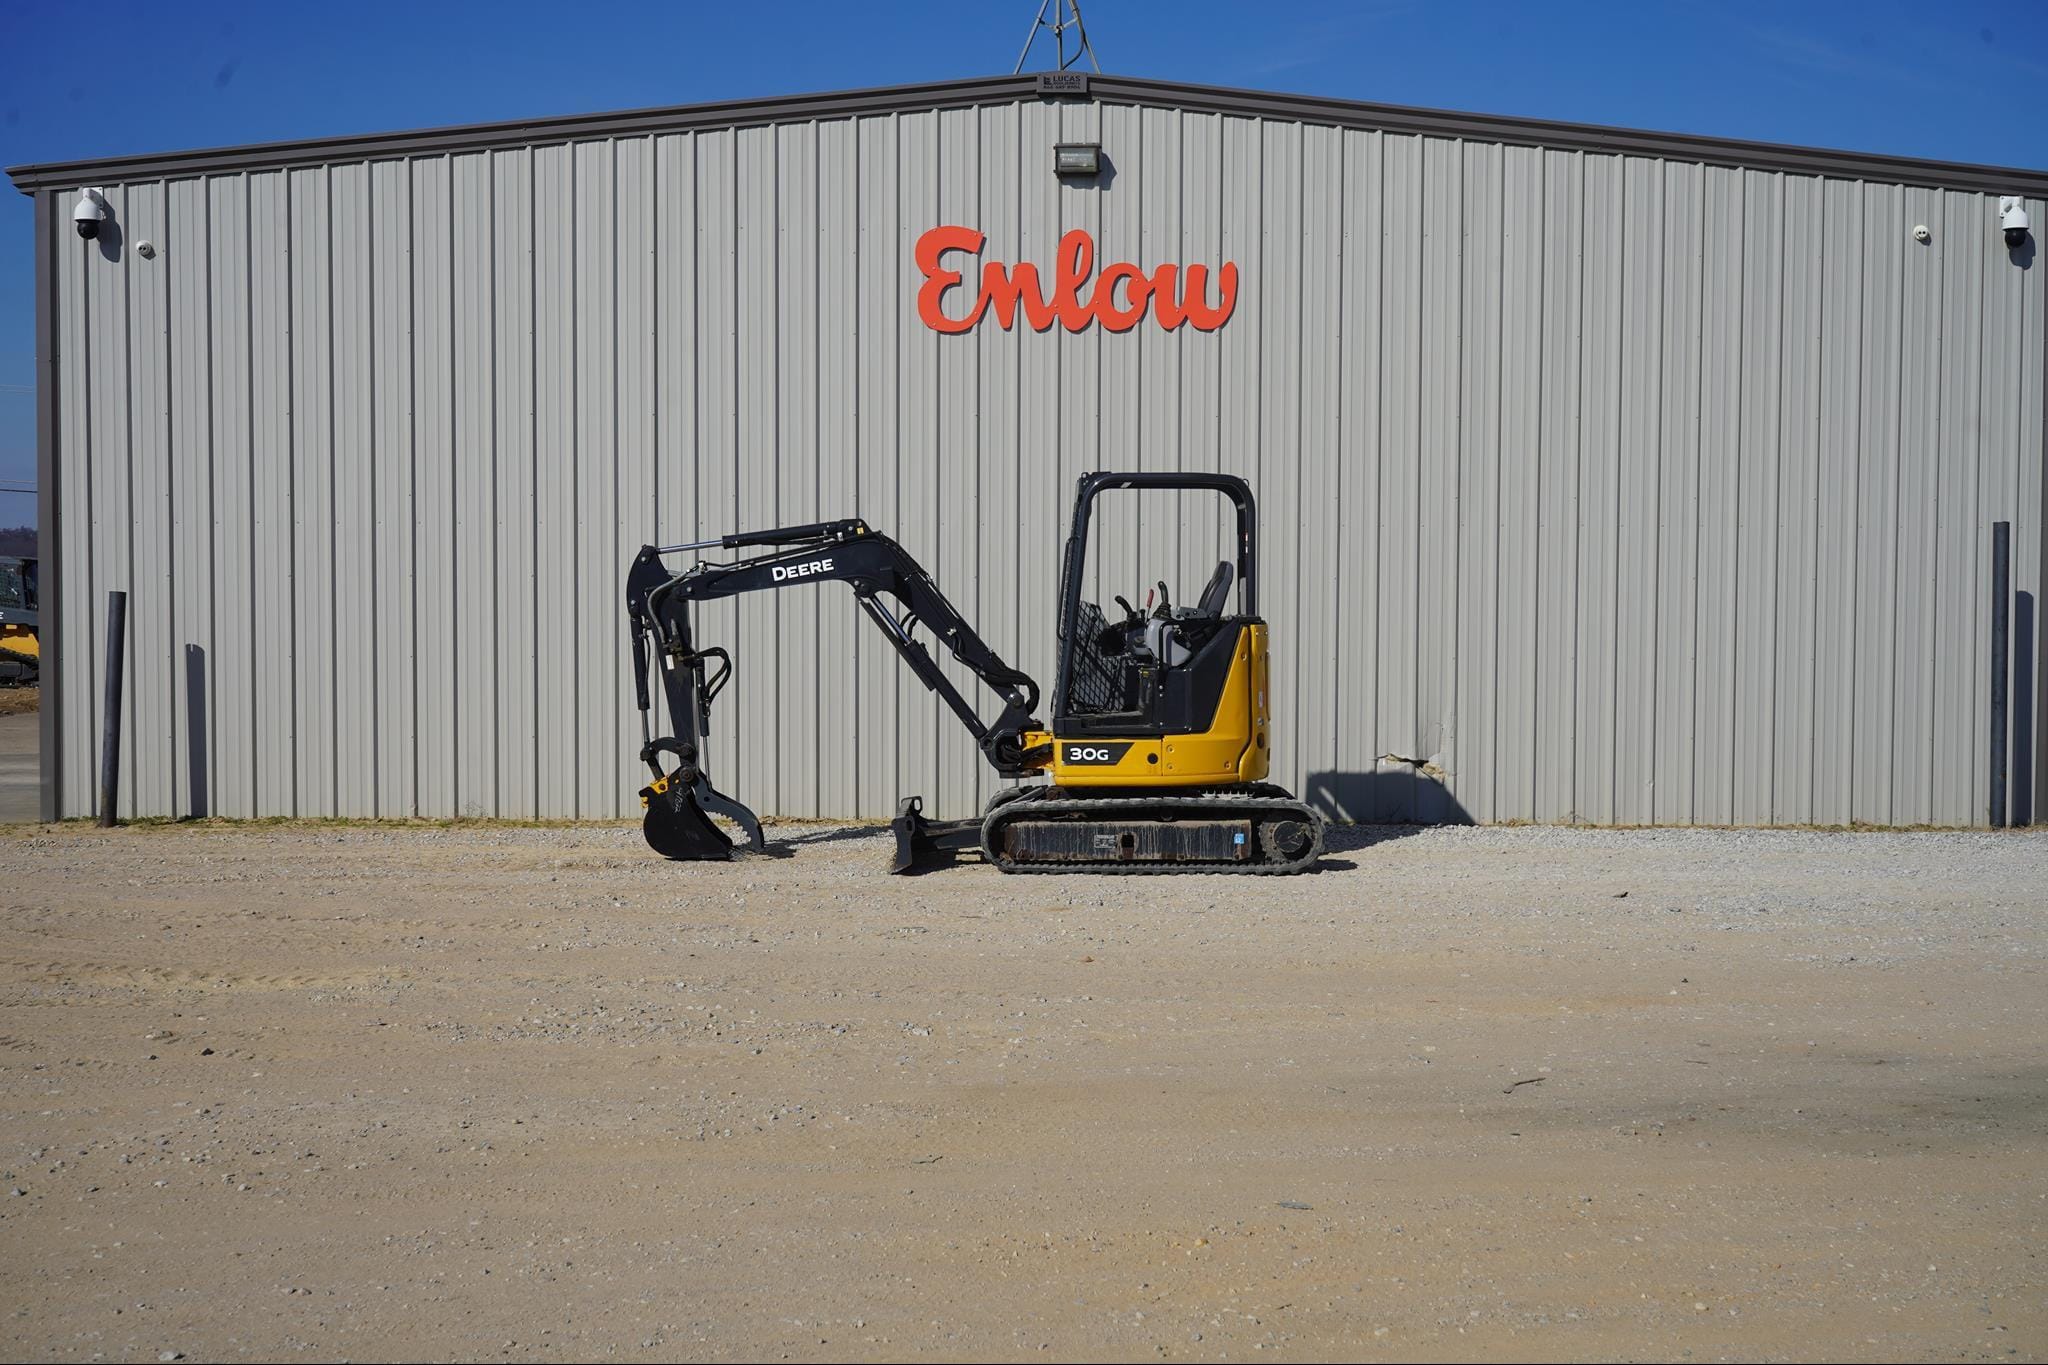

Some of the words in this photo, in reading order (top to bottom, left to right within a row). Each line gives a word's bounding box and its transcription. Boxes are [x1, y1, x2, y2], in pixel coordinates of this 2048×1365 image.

[916, 226, 1238, 333] Enlow
[772, 559, 834, 582] DEERE
[1070, 747, 1109, 761] 30G
